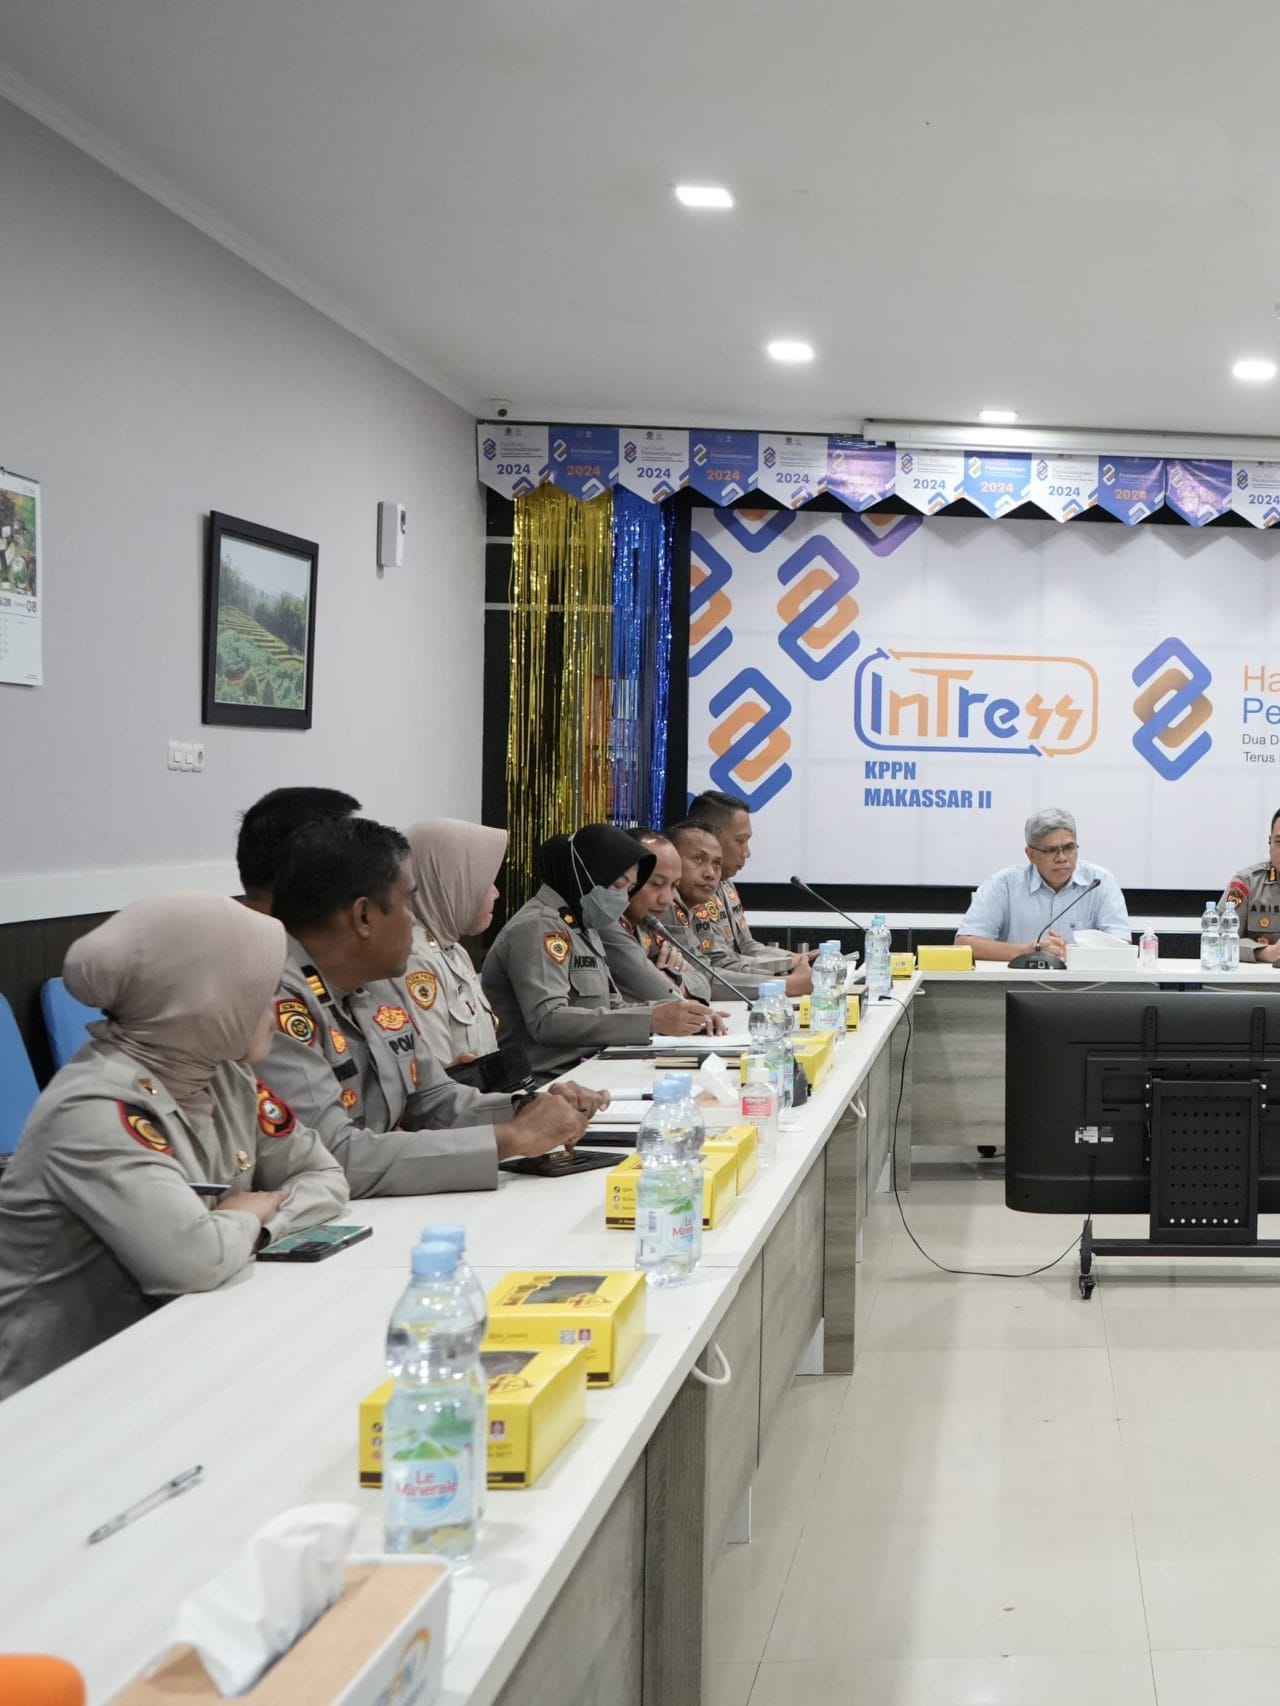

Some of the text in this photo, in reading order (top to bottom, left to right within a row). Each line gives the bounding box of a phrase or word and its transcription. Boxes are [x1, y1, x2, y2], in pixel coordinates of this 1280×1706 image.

[497, 463, 531, 476] 2024
[567, 464, 600, 477] 2024
[636, 467, 671, 479] 2024
[706, 469, 741, 481] 2024
[775, 472, 810, 484] 2024
[912, 478, 946, 490] 2024
[980, 481, 1014, 494] 2024
[1048, 485, 1081, 497] 2024
[1248, 493, 1280, 506] 2024
[1242, 734, 1266, 746] Dua
[1243, 751, 1276, 764] Terus
[865, 760, 917, 780] KPPN
[864, 788, 992, 809] MAKASSAR II
[1250, 904, 1280, 914] ARIS
[415, 1469, 435, 1484] Le
